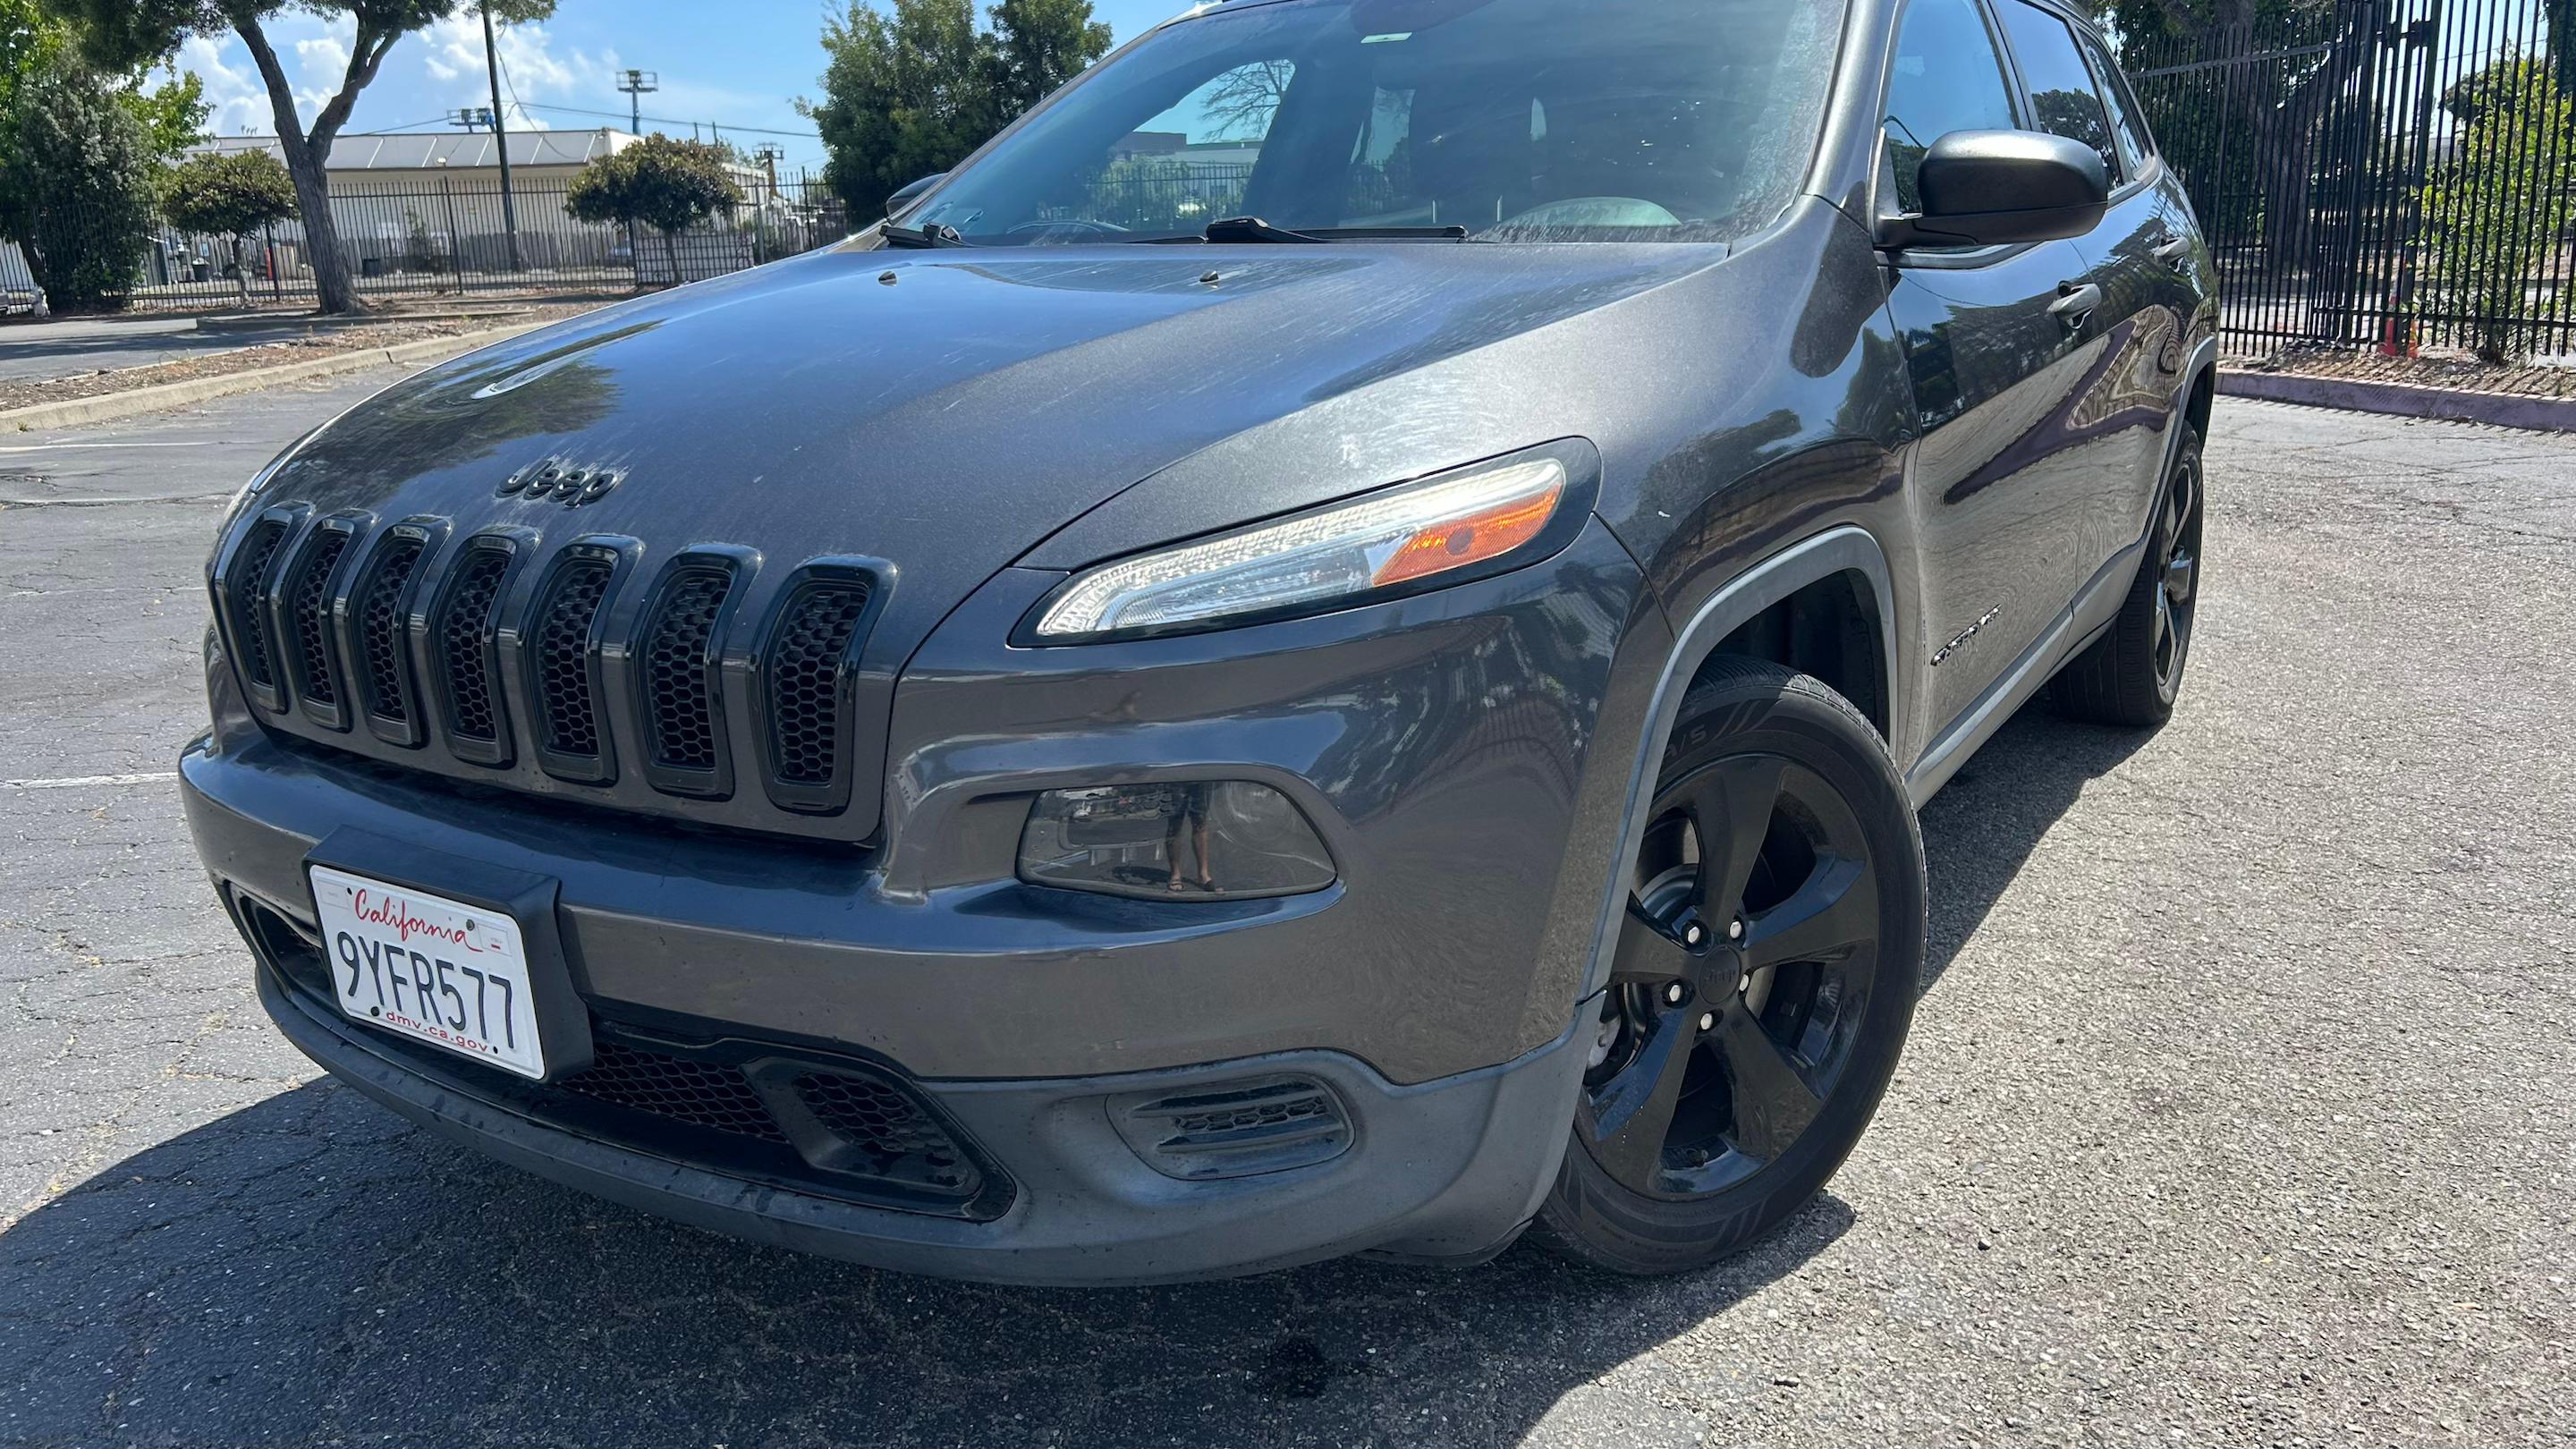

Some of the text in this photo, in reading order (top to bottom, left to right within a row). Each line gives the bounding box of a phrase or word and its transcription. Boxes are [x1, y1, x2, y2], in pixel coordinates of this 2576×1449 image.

[495, 460, 619, 508] Jeep
[355, 888, 483, 953] California
[336, 931, 514, 1049] 9YFR577
[386, 1011, 488, 1053] dmv.ca.gov
